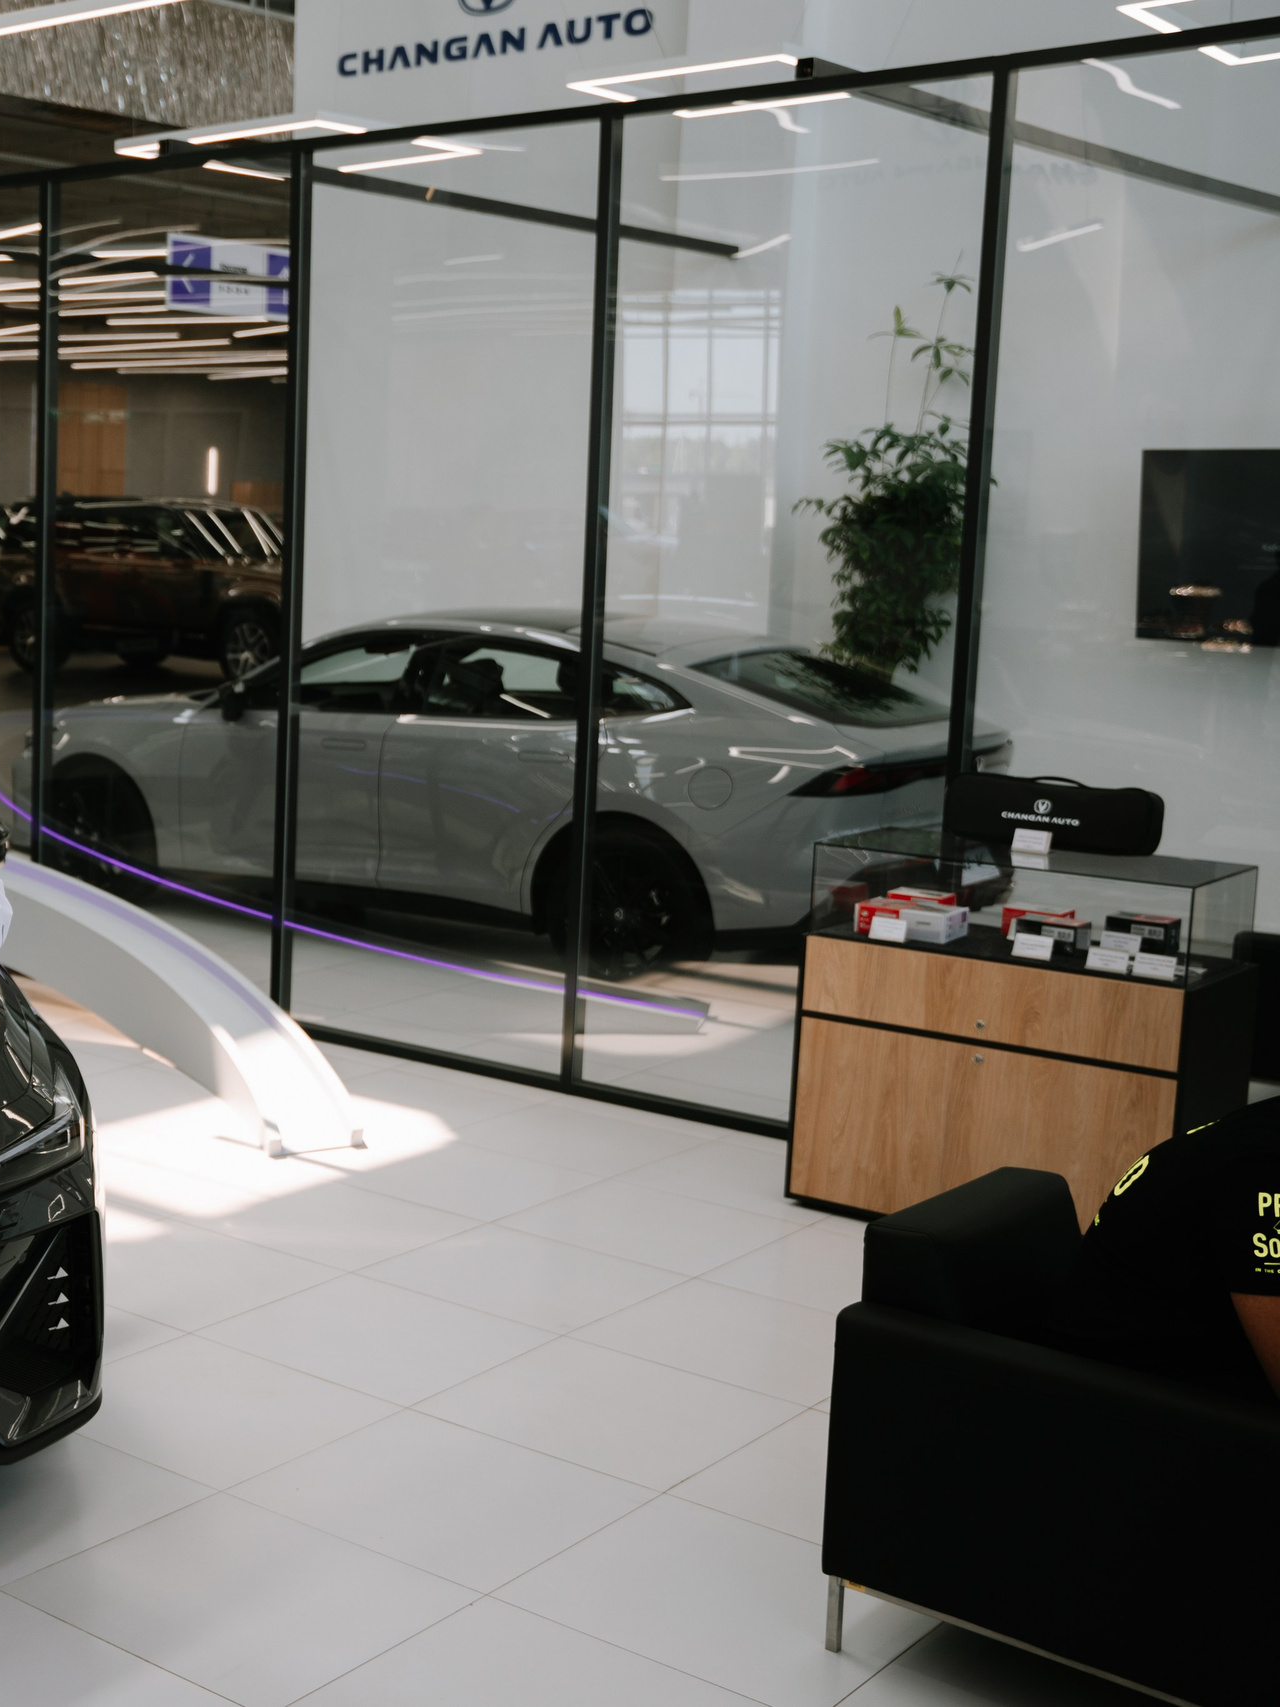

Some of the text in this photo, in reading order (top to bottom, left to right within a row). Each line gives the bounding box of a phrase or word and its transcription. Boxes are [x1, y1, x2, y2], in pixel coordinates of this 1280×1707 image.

[337, 8, 653, 77] CHANGAN AUTO
[1001, 811, 1080, 827] CHANGAN AUTO
